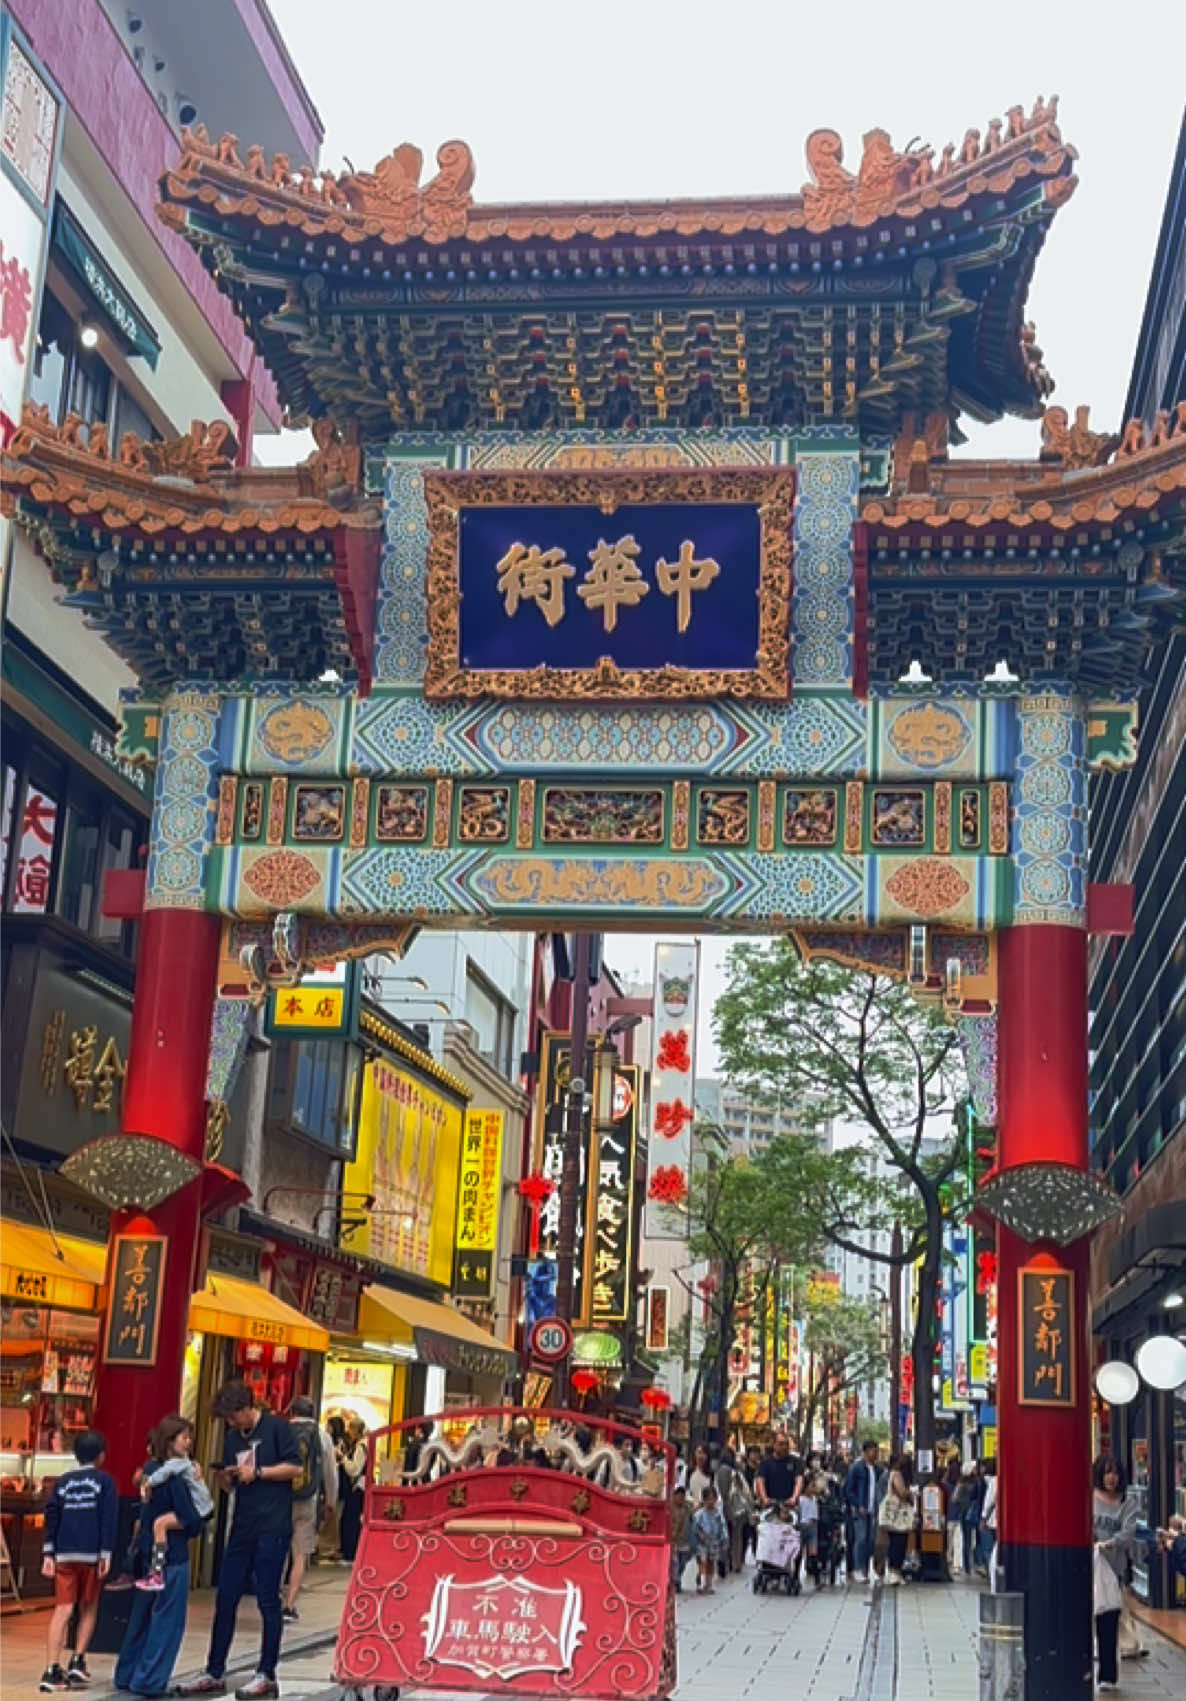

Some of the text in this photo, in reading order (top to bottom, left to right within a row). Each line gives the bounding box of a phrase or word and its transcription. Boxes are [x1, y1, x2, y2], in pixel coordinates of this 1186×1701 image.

[496, 535, 720, 633] 中華街
[284, 995, 335, 1018] 本店
[461, 1117, 482, 1241] 世界一の肉まん
[541, 1330, 561, 1348] 30
[472, 1594, 537, 1617] 不准
